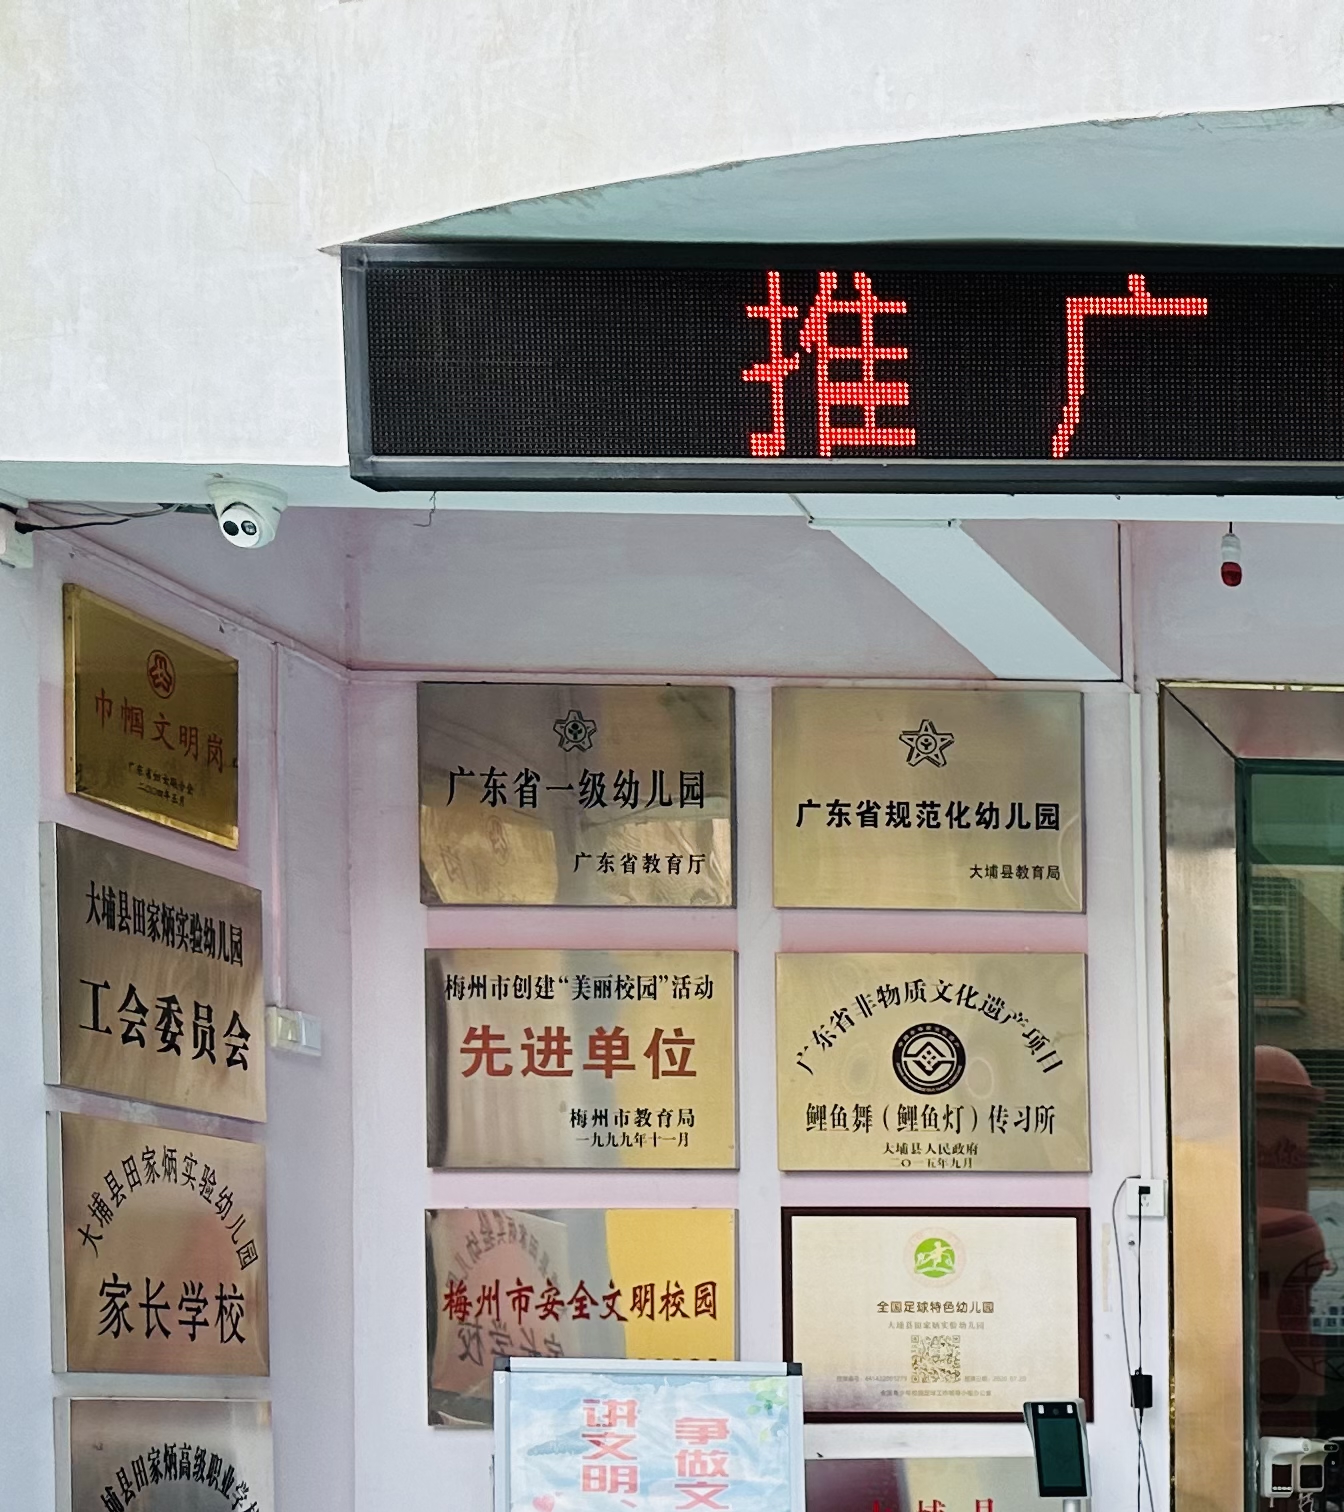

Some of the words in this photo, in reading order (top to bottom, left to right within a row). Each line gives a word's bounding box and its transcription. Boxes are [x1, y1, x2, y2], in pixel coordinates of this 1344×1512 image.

[95, 688, 225, 774] 巾帼文明岗
[446, 767, 706, 809] 广东省一级幼儿园
[795, 799, 1061, 832] 广东省规范化幼儿园
[572, 851, 707, 876] 广东省教育厅
[969, 863, 1062, 881] 大埔县教育局
[84, 880, 245, 969] 大埔县田家炳实验幼儿园
[79, 977, 253, 1072] 工会委员会
[795, 978, 1064, 1076] 广东省非物质文化遗产项目
[460, 1026, 698, 1080] 先进单位
[569, 1107, 696, 1130] 梅州市教育局
[575, 1131, 691, 1149] 一九九九年十一月
[882, 1142, 979, 1156] 大埔县人民政府
[76, 1144, 259, 1272] 大埔县田家炳实验幼儿园
[97, 1272, 247, 1345] 家长学校
[442, 1276, 718, 1326] 梅州市安全文明校园
[877, 1300, 995, 1314] 全国足球特色幼儿园
